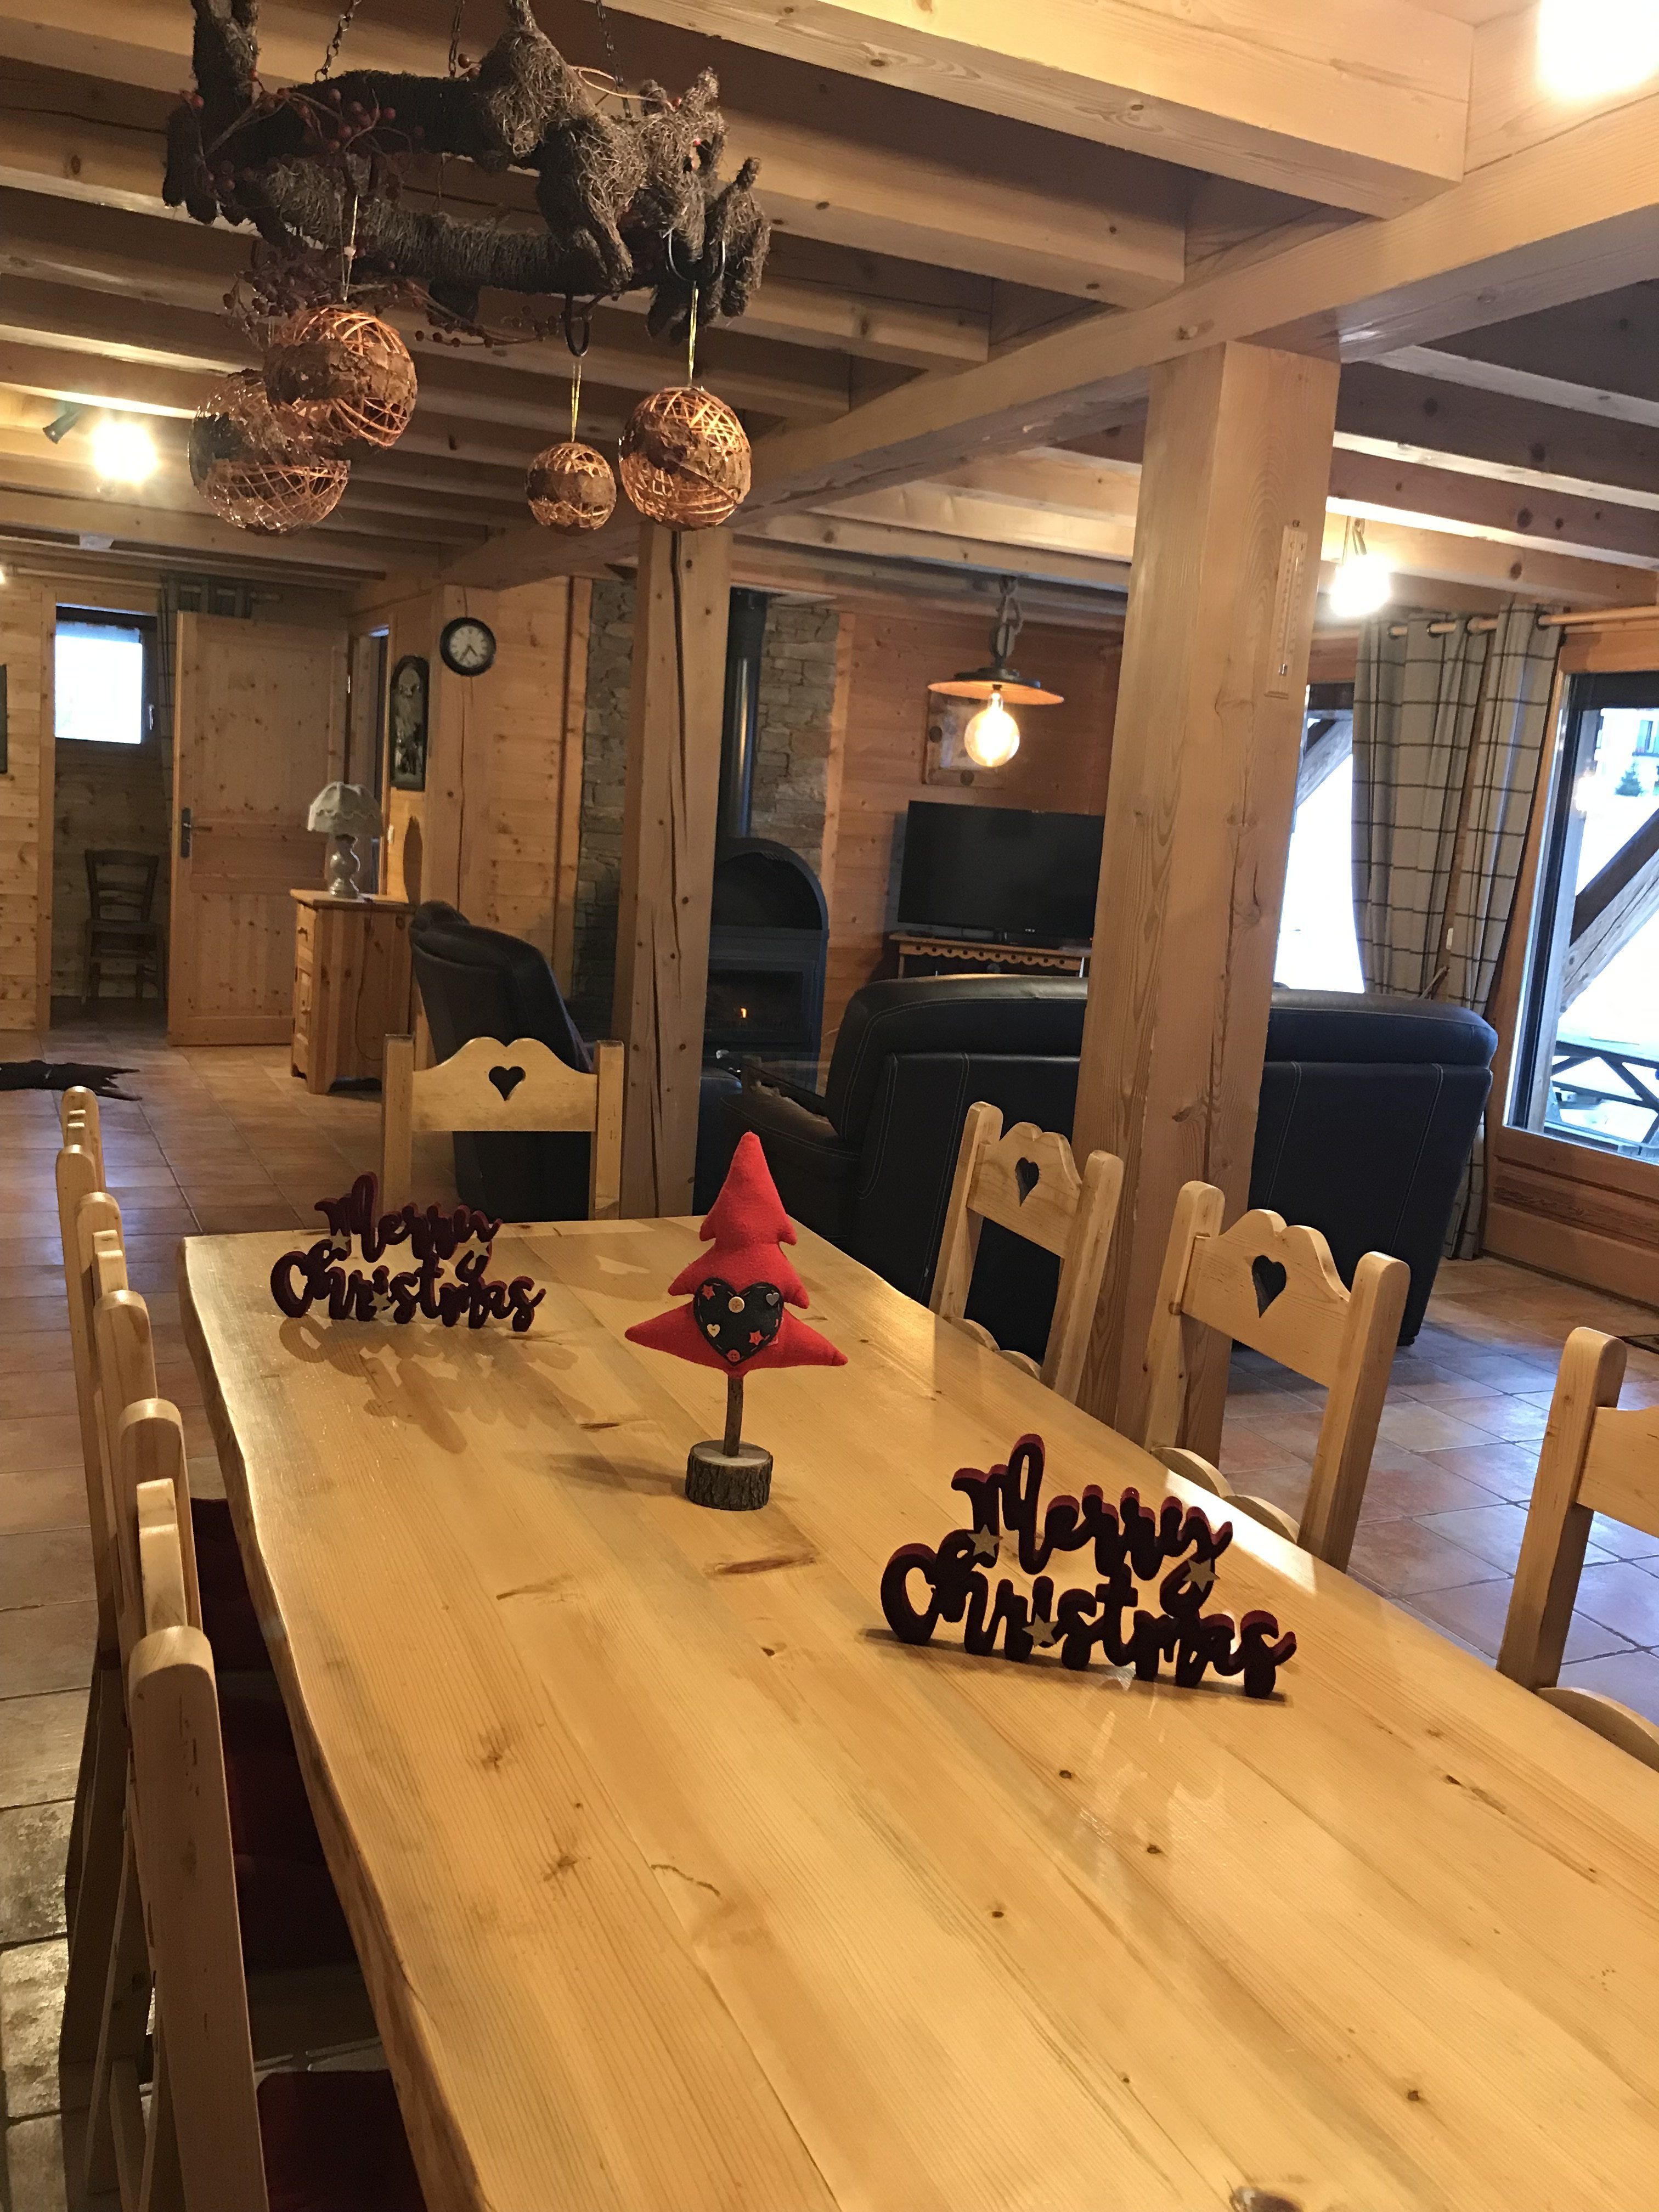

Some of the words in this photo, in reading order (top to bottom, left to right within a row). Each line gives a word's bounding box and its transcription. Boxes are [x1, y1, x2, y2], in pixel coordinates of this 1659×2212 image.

[270, 1238, 546, 1332] Christmas
[314, 1171, 503, 1283] Merry
[951, 1434, 1233, 1617] Merry
[881, 1528, 1297, 1699] Christmas
